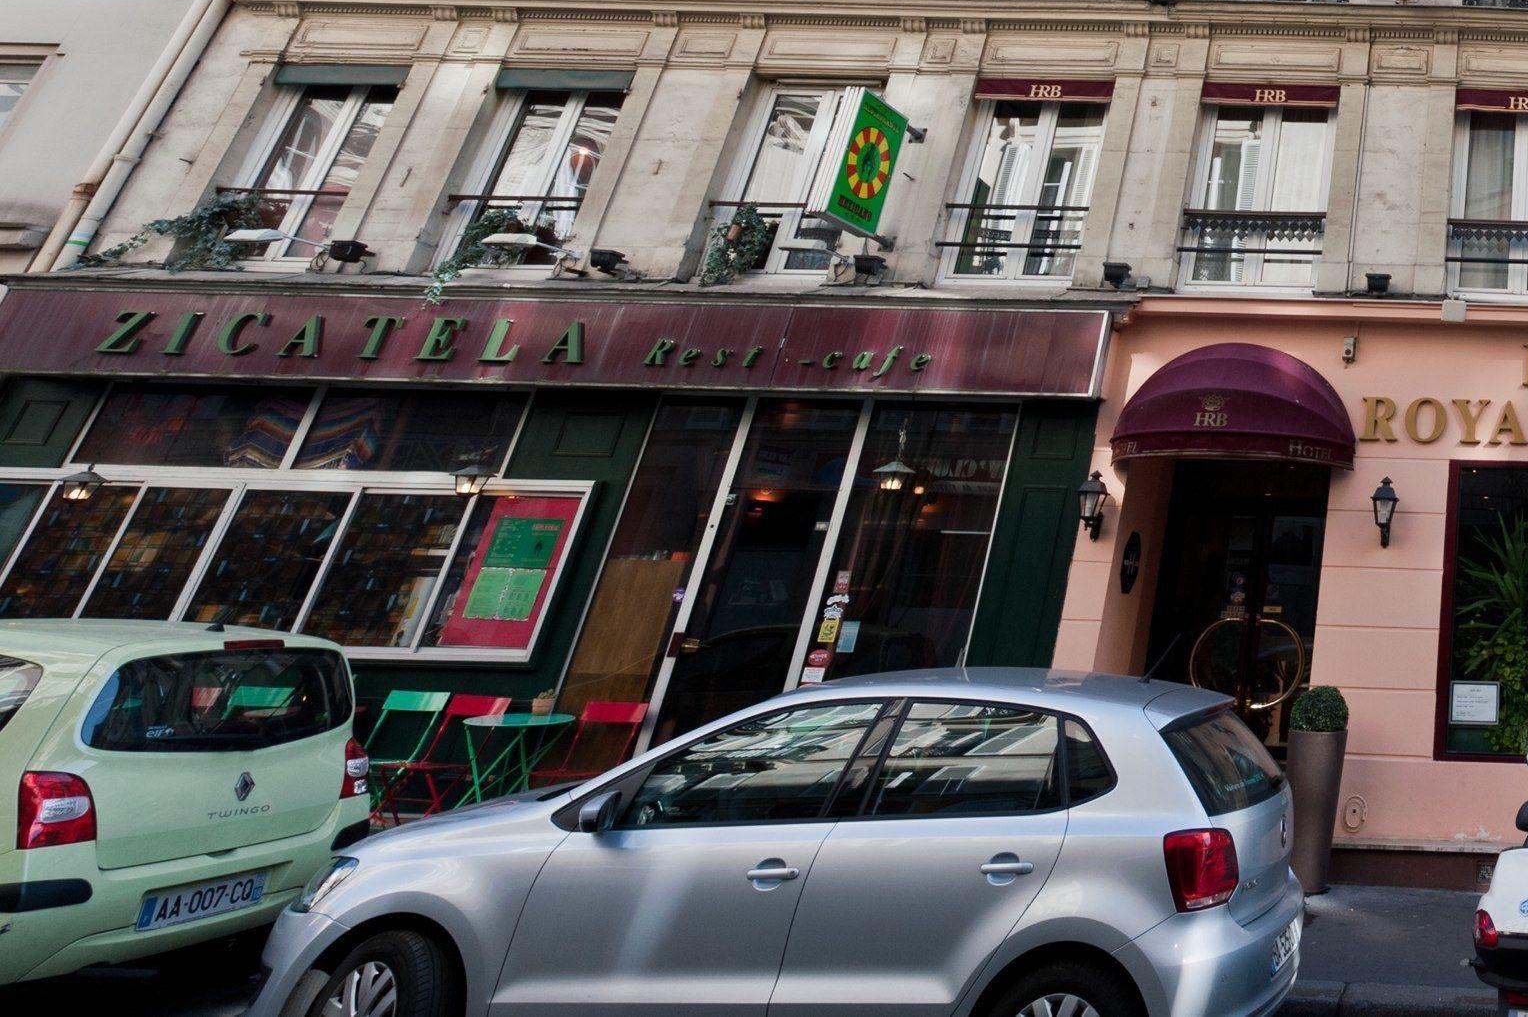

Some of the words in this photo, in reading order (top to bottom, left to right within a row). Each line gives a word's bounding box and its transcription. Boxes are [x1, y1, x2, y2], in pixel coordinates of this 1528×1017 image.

[1030, 84, 1062, 98] HRB
[1254, 89, 1286, 102] HRB
[94, 310, 586, 365] ZICATELA
[1193, 412, 1229, 427] HRB
[207, 804, 271, 820] TWINGO
